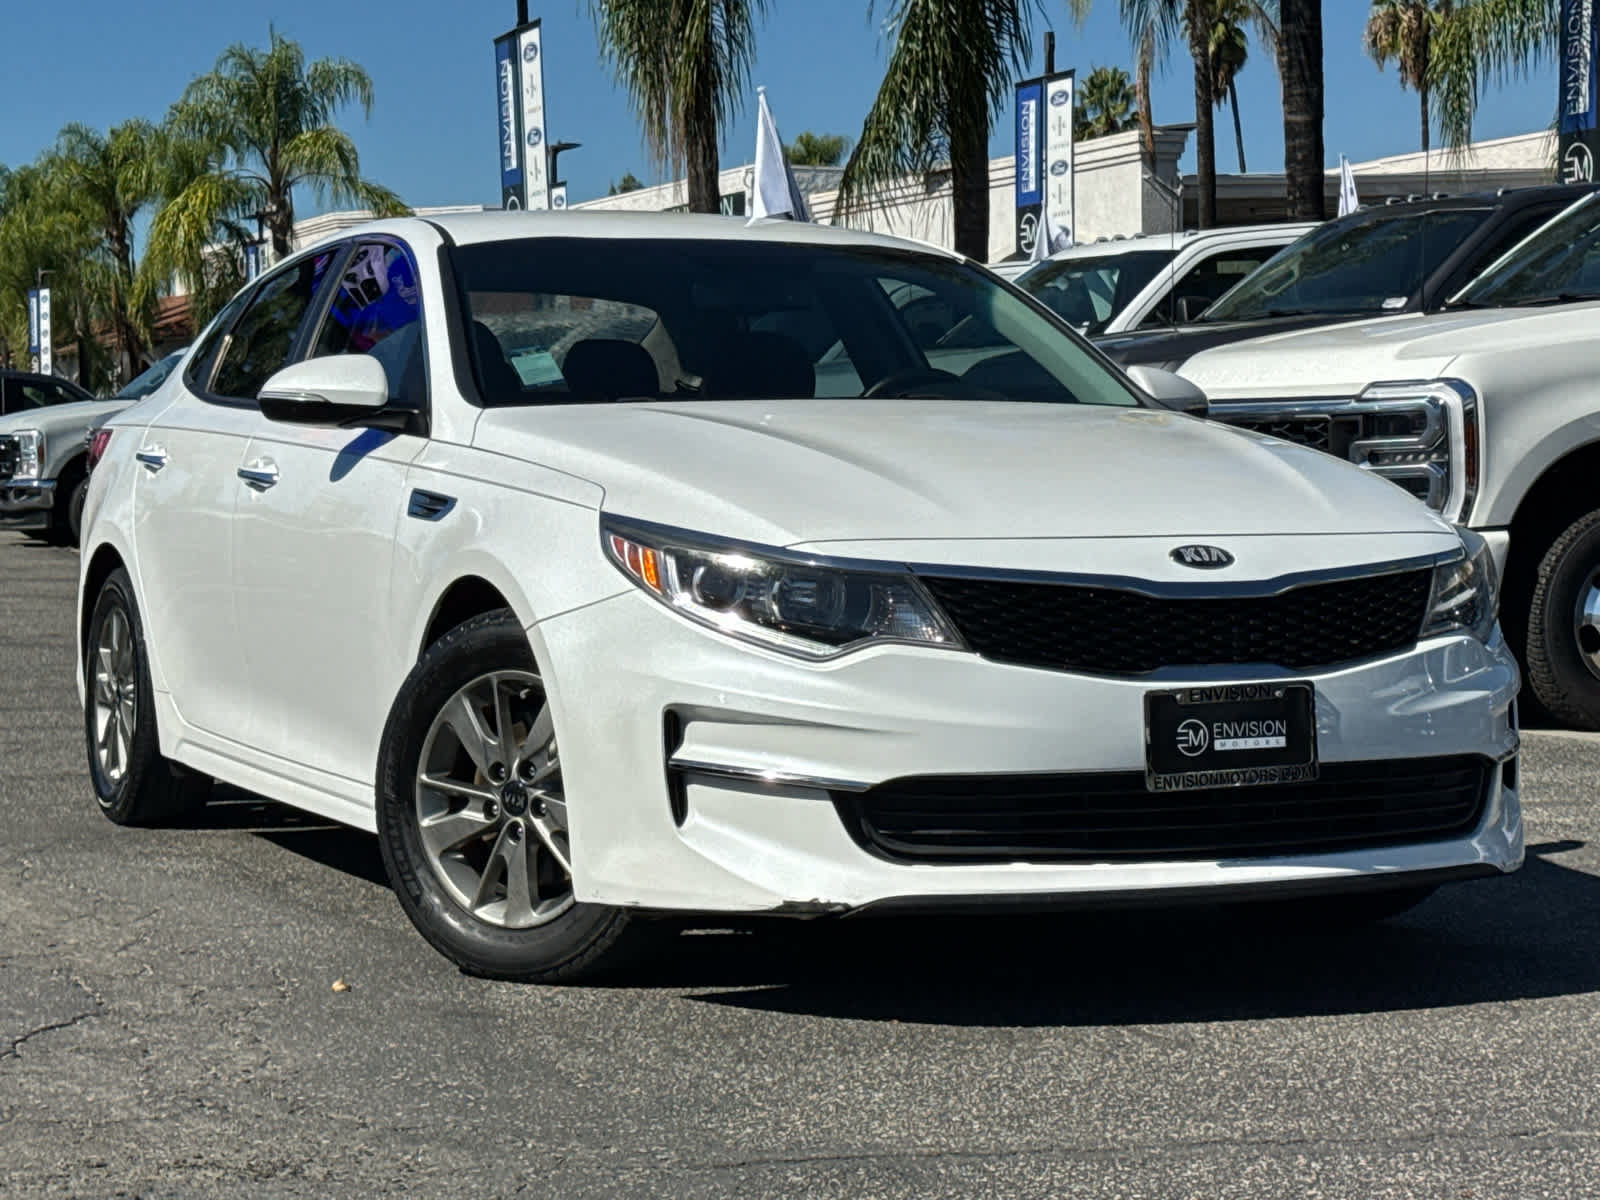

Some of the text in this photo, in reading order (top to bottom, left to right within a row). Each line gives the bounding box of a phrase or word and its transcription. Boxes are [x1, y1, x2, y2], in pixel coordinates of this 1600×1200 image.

[500, 59, 512, 171] ENVISION
[1021, 101, 1031, 192] ENVISION
[1179, 547, 1227, 562] KIA
[1190, 685, 1271, 702] ENVISION
[1213, 720, 1287, 738] ENVISION
[1219, 739, 1281, 748] MOTORS
